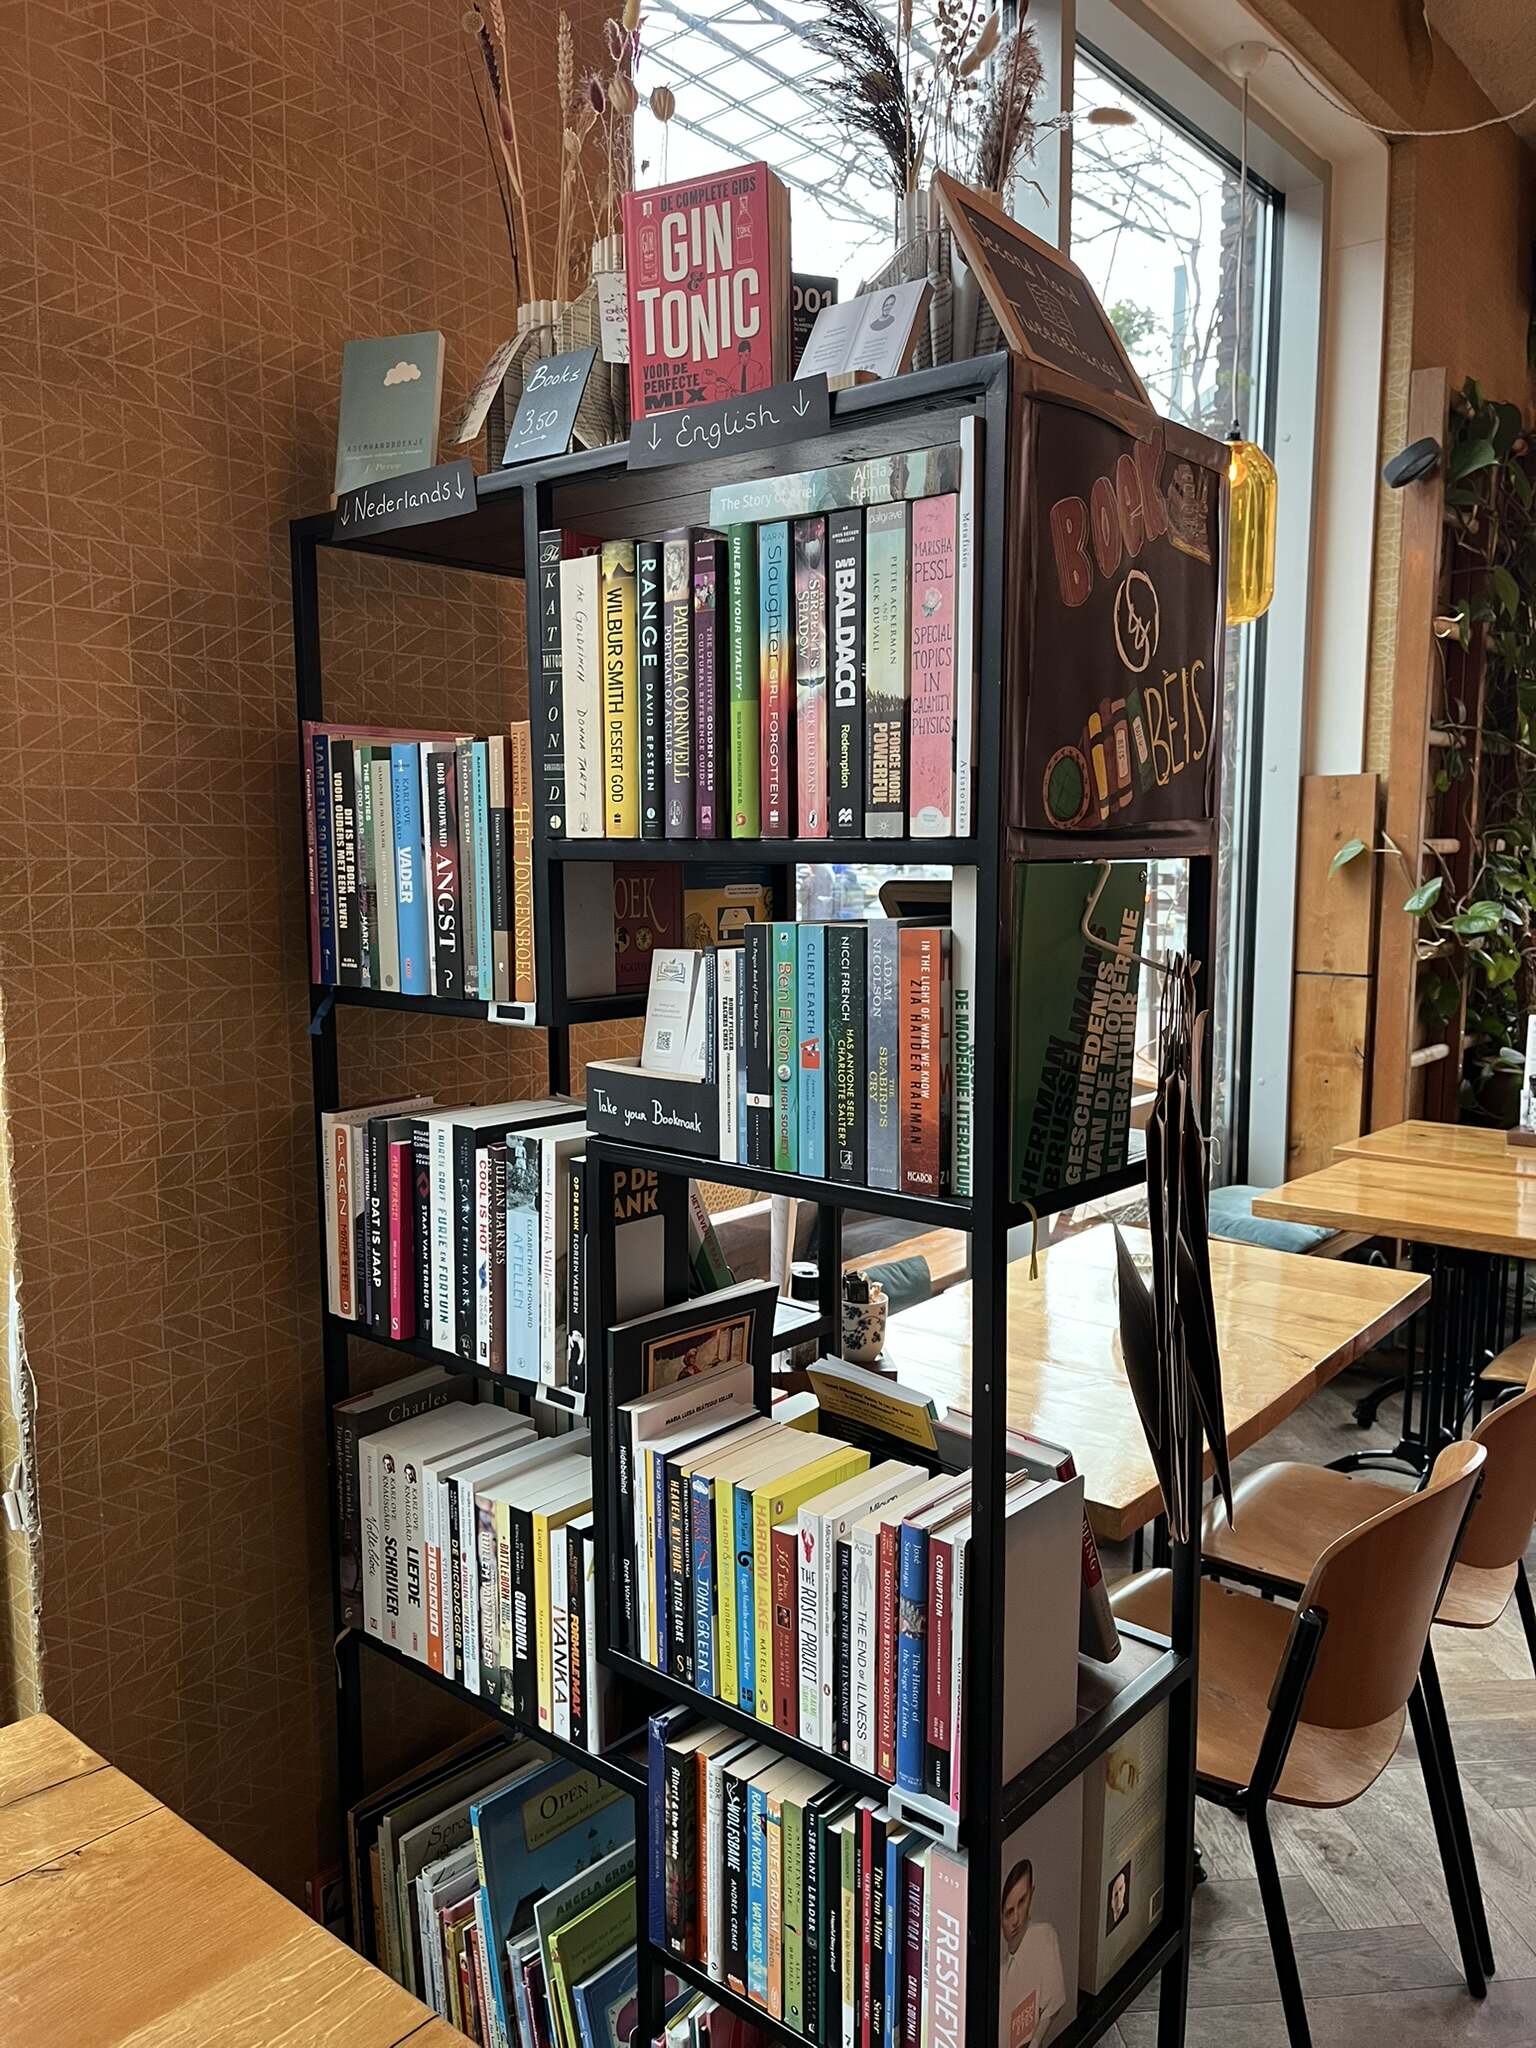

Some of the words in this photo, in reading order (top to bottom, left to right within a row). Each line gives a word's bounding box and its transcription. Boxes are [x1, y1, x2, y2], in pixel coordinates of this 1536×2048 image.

[661, 196, 674, 212] DE
[676, 185, 730, 209] COMPLETE
[732, 177, 756, 195] GIDS
[661, 201, 733, 283] GIN
[637, 268, 760, 362] TONIC
[527, 363, 579, 393] Books
[642, 364, 670, 380] VOOR
[672, 362, 688, 374] DE
[644, 374, 701, 394] PERFECTE
[644, 386, 706, 410] MIX
[676, 404, 781, 449] English
[354, 482, 451, 524] Nederlands
[733, 537, 741, 595] UNLEASH
[914, 539, 952, 560] MARISHA
[914, 559, 953, 585] PESSL
[607, 588, 623, 657] WILBUR
[641, 559, 657, 668] RANGE
[734, 600, 742, 632] YOUR
[764, 545, 782, 662] Slaughter
[673, 605, 689, 682] PATRICIA
[835, 567, 855, 708] BALDACCI
[913, 624, 952, 646] SPECIAL
[734, 637, 742, 690] VITALITY
[913, 646, 952, 669] TOPICS
[608, 661, 624, 714] SMITH
[923, 672, 940, 691] IN
[645, 683, 654, 726] DAVID
[611, 720, 623, 763] DESERT
[674, 686, 690, 784] CORNWELL
[891, 721, 900, 730] A
[912, 715, 952, 736] PHYSICS
[647, 734, 655, 791] EPSTEIN
[769, 711, 779, 805] FORGOTTEN
[840, 724, 850, 788] Redemption
[872, 722, 887, 804] POWERFUL
[891, 732, 900, 767] FORCE
[334, 772, 343, 802] VOOR
[437, 762, 445, 784] BOB
[611, 767, 624, 803] GOD
[891, 770, 901, 803] MORE
[335, 805, 344, 847] OUDERS
[344, 809, 353, 826] DIT
[345, 829, 353, 840] IS
[438, 787, 448, 848] WOODWARD
[513, 802, 531, 847] HET
[337, 849, 345, 872] MET
[345, 842, 354, 863] HET
[338, 875, 346, 894] EEN
[346, 865, 355, 894] BOEK
[400, 847, 413, 905] VADER
[339, 896, 347, 929] LEVEN
[437, 852, 456, 953] ANGST
[515, 856, 532, 982] JONGENSBOEK
[841, 936, 850, 969] NICCI
[923, 940, 930, 952] IN
[778, 962, 792, 1003] Ben
[807, 943, 815, 990] CLIENT
[873, 938, 881, 1018] NICOLSON
[883, 955, 892, 1001] ADAM
[841, 973, 850, 1021] FRENCH
[910, 980, 921, 1004] ZIA
[955, 989, 969, 1011] DE
[807, 993, 815, 1034] EARTH
[922, 1009, 930, 1020] OF
[778, 1008, 791, 1068] Elton
[846, 1028, 854, 1044] HAS
[910, 1014, 921, 1074] HAIDER
[922, 1023, 930, 1049] WHAT
[846, 1047, 854, 1092] ANYONE
[922, 1051, 929, 1068] WE
[1065, 960, 1115, 1186] GESCHIEDENIS
[869, 1071, 878, 1102] CRY
[879, 1046, 888, 1128] SEABIRD'S
[1095, 1071, 1113, 1111] DE
[1107, 993, 1138, 1174] LITERATUUR
[594, 1088, 618, 1116] Take
[624, 1108, 647, 1126] your
[652, 1099, 702, 1133] Bookmark
[838, 1103, 846, 1147] SALTER?
[910, 1081, 921, 1145] RAHMAN
[780, 1114, 788, 1158] SOCIETY
[1086, 1114, 1105, 1181] VAN
[479, 1160, 487, 1200] COOL
[493, 1158, 505, 1206] JULIAN
[573, 1176, 580, 1190] OP
[573, 1192, 580, 1204] DE
[371, 1197, 381, 1228] DAT
[480, 1204, 487, 1219] IS
[372, 1231, 380, 1246] IS
[480, 1224, 488, 1254] HOT
[495, 1212, 505, 1265] BARNES
[372, 1248, 382, 1288] JAAP
[619, 1445, 628, 1494] Hidebehind
[672, 1527, 681, 1543] MY
[384, 1535, 399, 1617] SCHRIJVER
[407, 1546, 421, 1609] LIEFDE
[622, 1559, 630, 1585] Derek
[672, 1545, 682, 1575] HOME
[801, 1568, 815, 1585] THE
[673, 1580, 683, 1613] ATTICA
[697, 1578, 711, 1615] JOHN
[882, 1570, 890, 1629] MOUNTAINS
[934, 1555, 944, 1617] CORRUPTION
[514, 1591, 527, 1660] GUARDIOLA
[800, 1586, 817, 1628] ROSIE
[856, 1610, 867, 1635] THE
[675, 1615, 684, 1644] LOCKE
[697, 1618, 711, 1672] GREEN
[553, 1605, 569, 1704] IVANKA
[801, 1632, 817, 1683] PROJECT
[856, 1638, 867, 1667] END
[882, 1633, 890, 1675] BEYOND
[857, 1670, 865, 1679] OF
[856, 1681, 867, 1739] ILLNESS
[882, 1678, 890, 1739] MOUNTAINS
[670, 1767, 680, 1800] Albert
[751, 1790, 762, 1842] RAINBOW
[671, 1829, 679, 1860] Whale
[727, 1800, 740, 1873] WOLFSBANE
[751, 1845, 762, 1888] ROWELL
[874, 1867, 882, 1886] The
[874, 1890, 882, 1914] Iron
[907, 1882, 919, 1918] RIVER
[874, 1918, 882, 1950] Mind
[907, 1920, 919, 1950] ROAD
